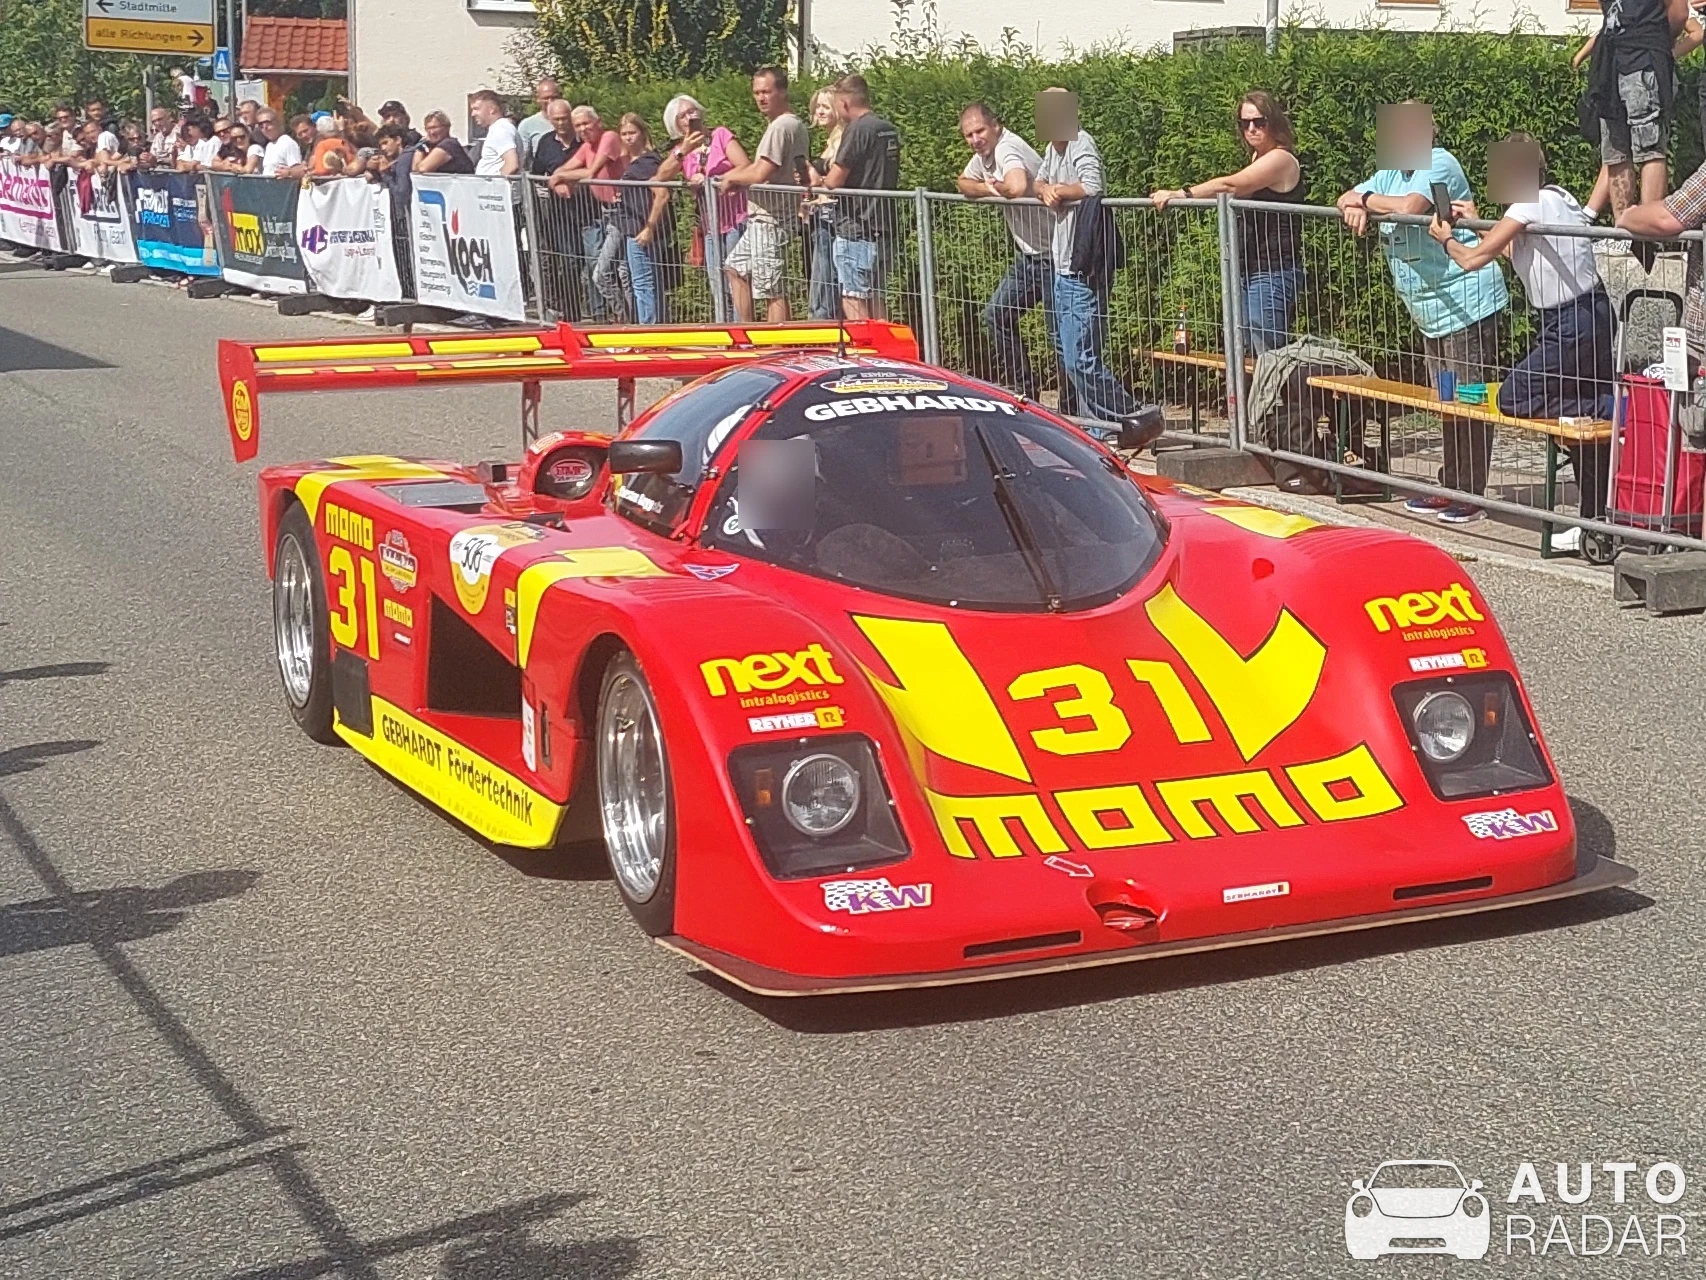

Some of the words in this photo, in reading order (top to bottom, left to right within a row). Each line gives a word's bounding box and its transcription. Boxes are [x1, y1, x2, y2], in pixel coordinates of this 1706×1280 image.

[119, 0, 178, 13] Stadtmitte
[95, 28, 117, 38] alle
[121, 29, 183, 43] Richtungen
[236, 226, 264, 256] max
[442, 224, 495, 295] KOCH
[804, 395, 1017, 421] GEBHARDT
[329, 546, 380, 661] 31
[1364, 582, 1485, 632] next
[1402, 625, 1475, 642] intralogistics
[700, 643, 845, 697] next
[740, 690, 830, 708] intralogistics
[1007, 659, 1213, 755] 31
[748, 713, 818, 733] REYHER
[382, 714, 442, 771] GEBHARDT
[447, 748, 533, 826] Fördertechnik
[1489, 812, 1551, 839] KW
[848, 885, 926, 911] KW
